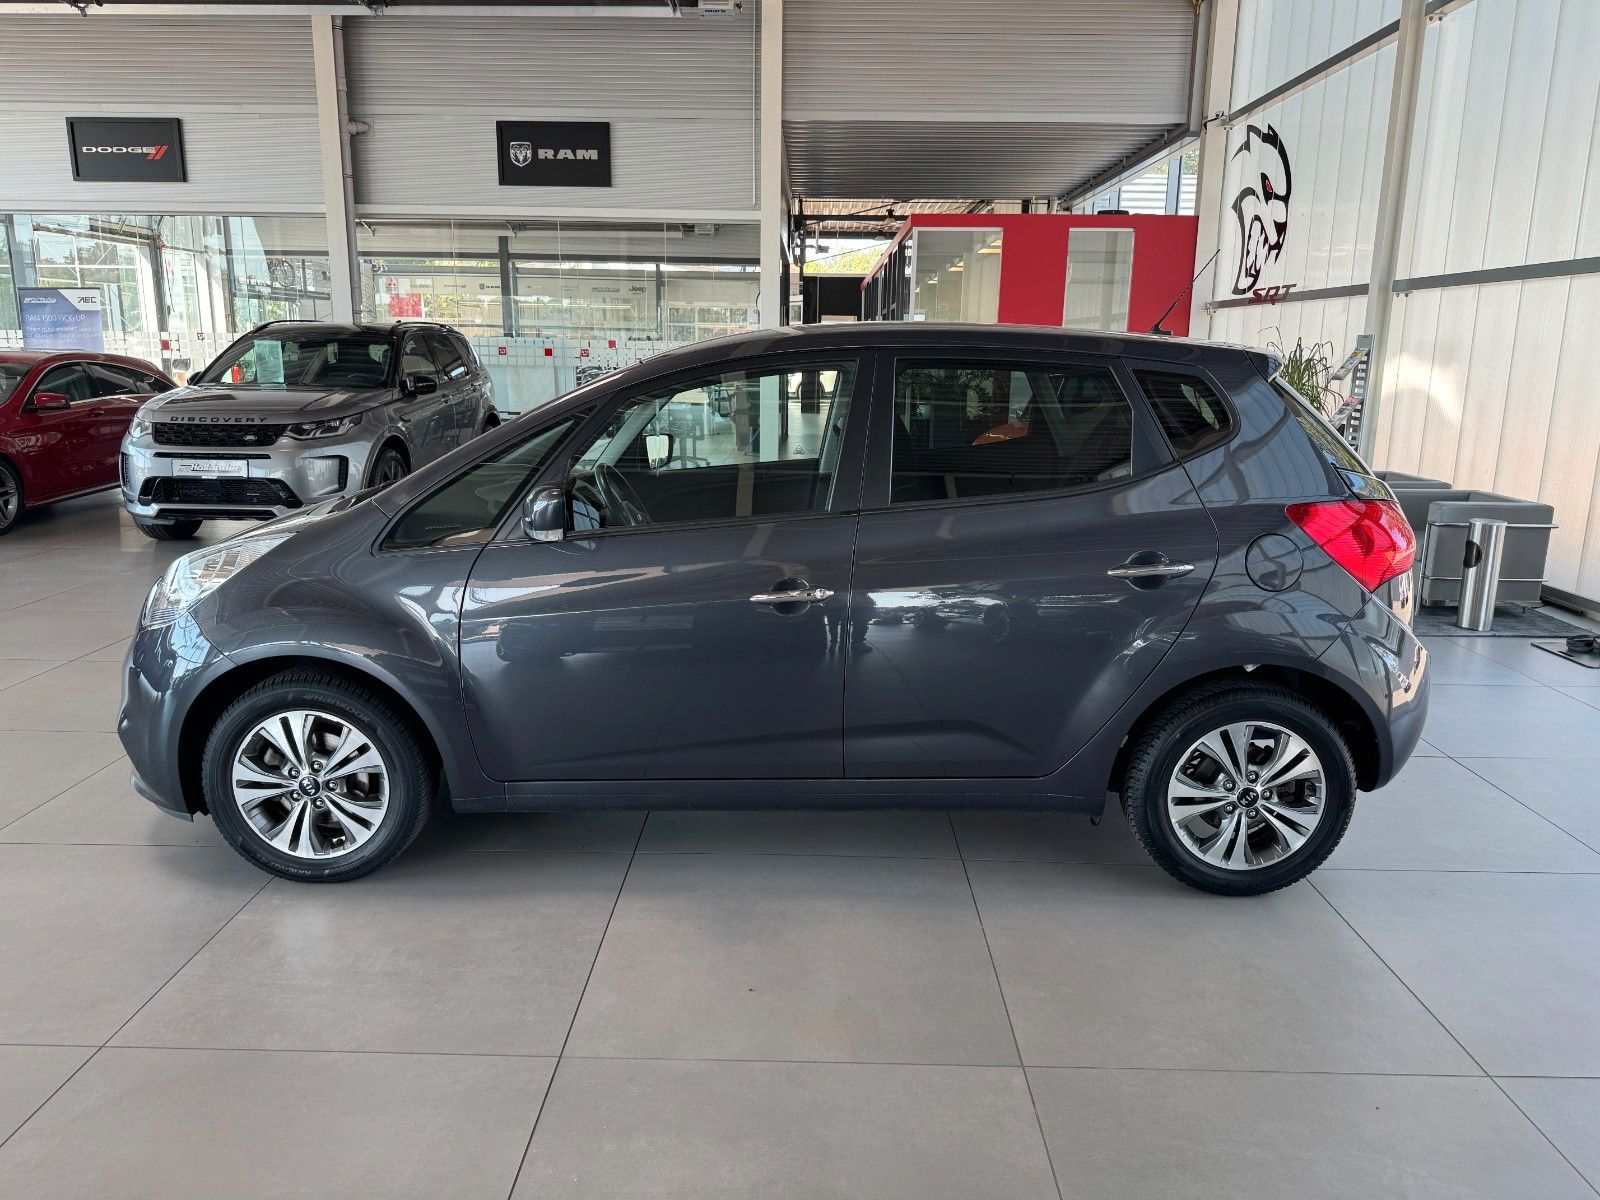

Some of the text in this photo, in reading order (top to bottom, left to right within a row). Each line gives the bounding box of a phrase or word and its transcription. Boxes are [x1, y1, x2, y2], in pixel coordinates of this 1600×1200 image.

[81, 146, 157, 154] DODGE
[537, 148, 599, 160] RAM
[628, 285, 647, 293] Jeep
[1247, 283, 1298, 306] SRT
[77, 296, 97, 304] AEC
[301, 777, 316, 796] KIA
[1240, 791, 1257, 806] KIA
